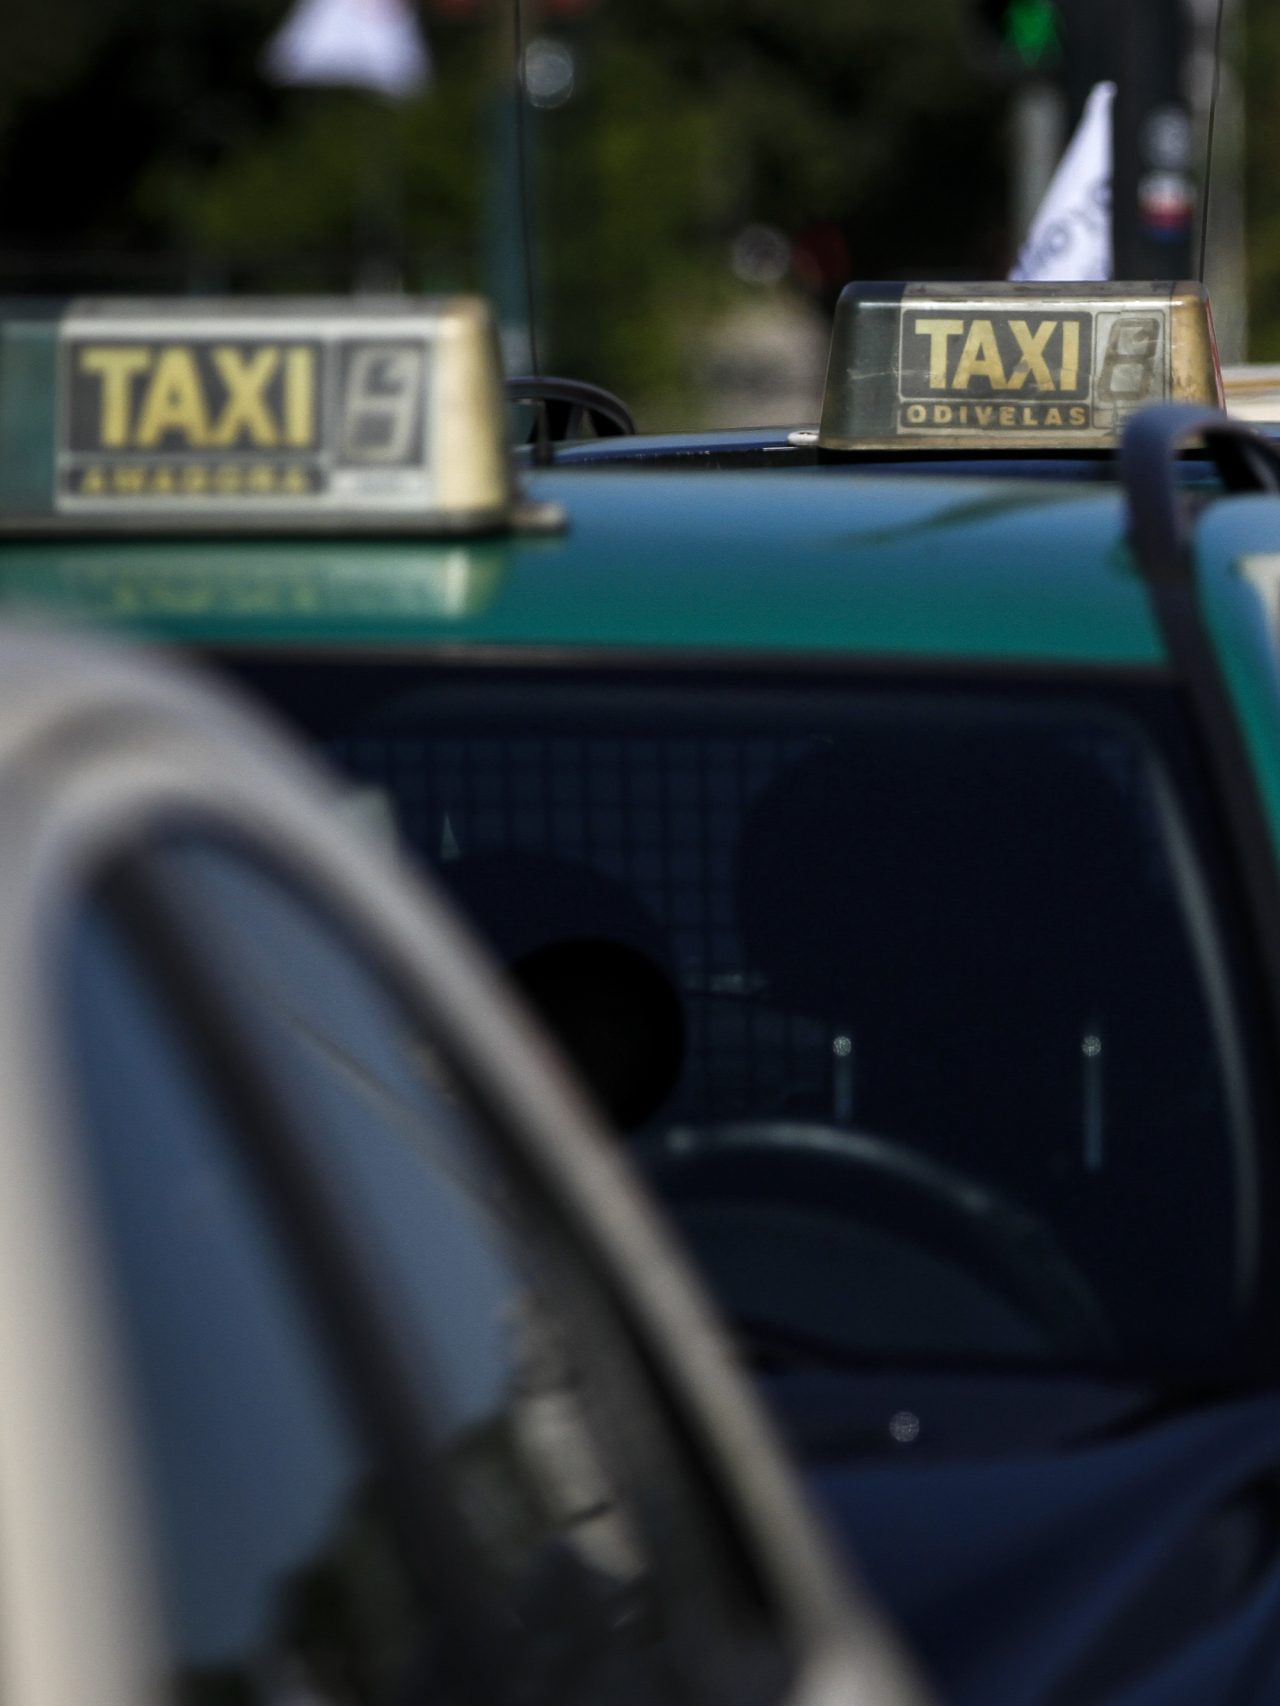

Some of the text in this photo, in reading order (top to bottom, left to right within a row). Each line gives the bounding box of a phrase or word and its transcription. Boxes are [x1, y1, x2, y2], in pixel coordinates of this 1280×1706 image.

[914, 319, 1080, 392] TAXI
[80, 345, 315, 447] TAXI
[906, 404, 1086, 426] ODIVELAS
